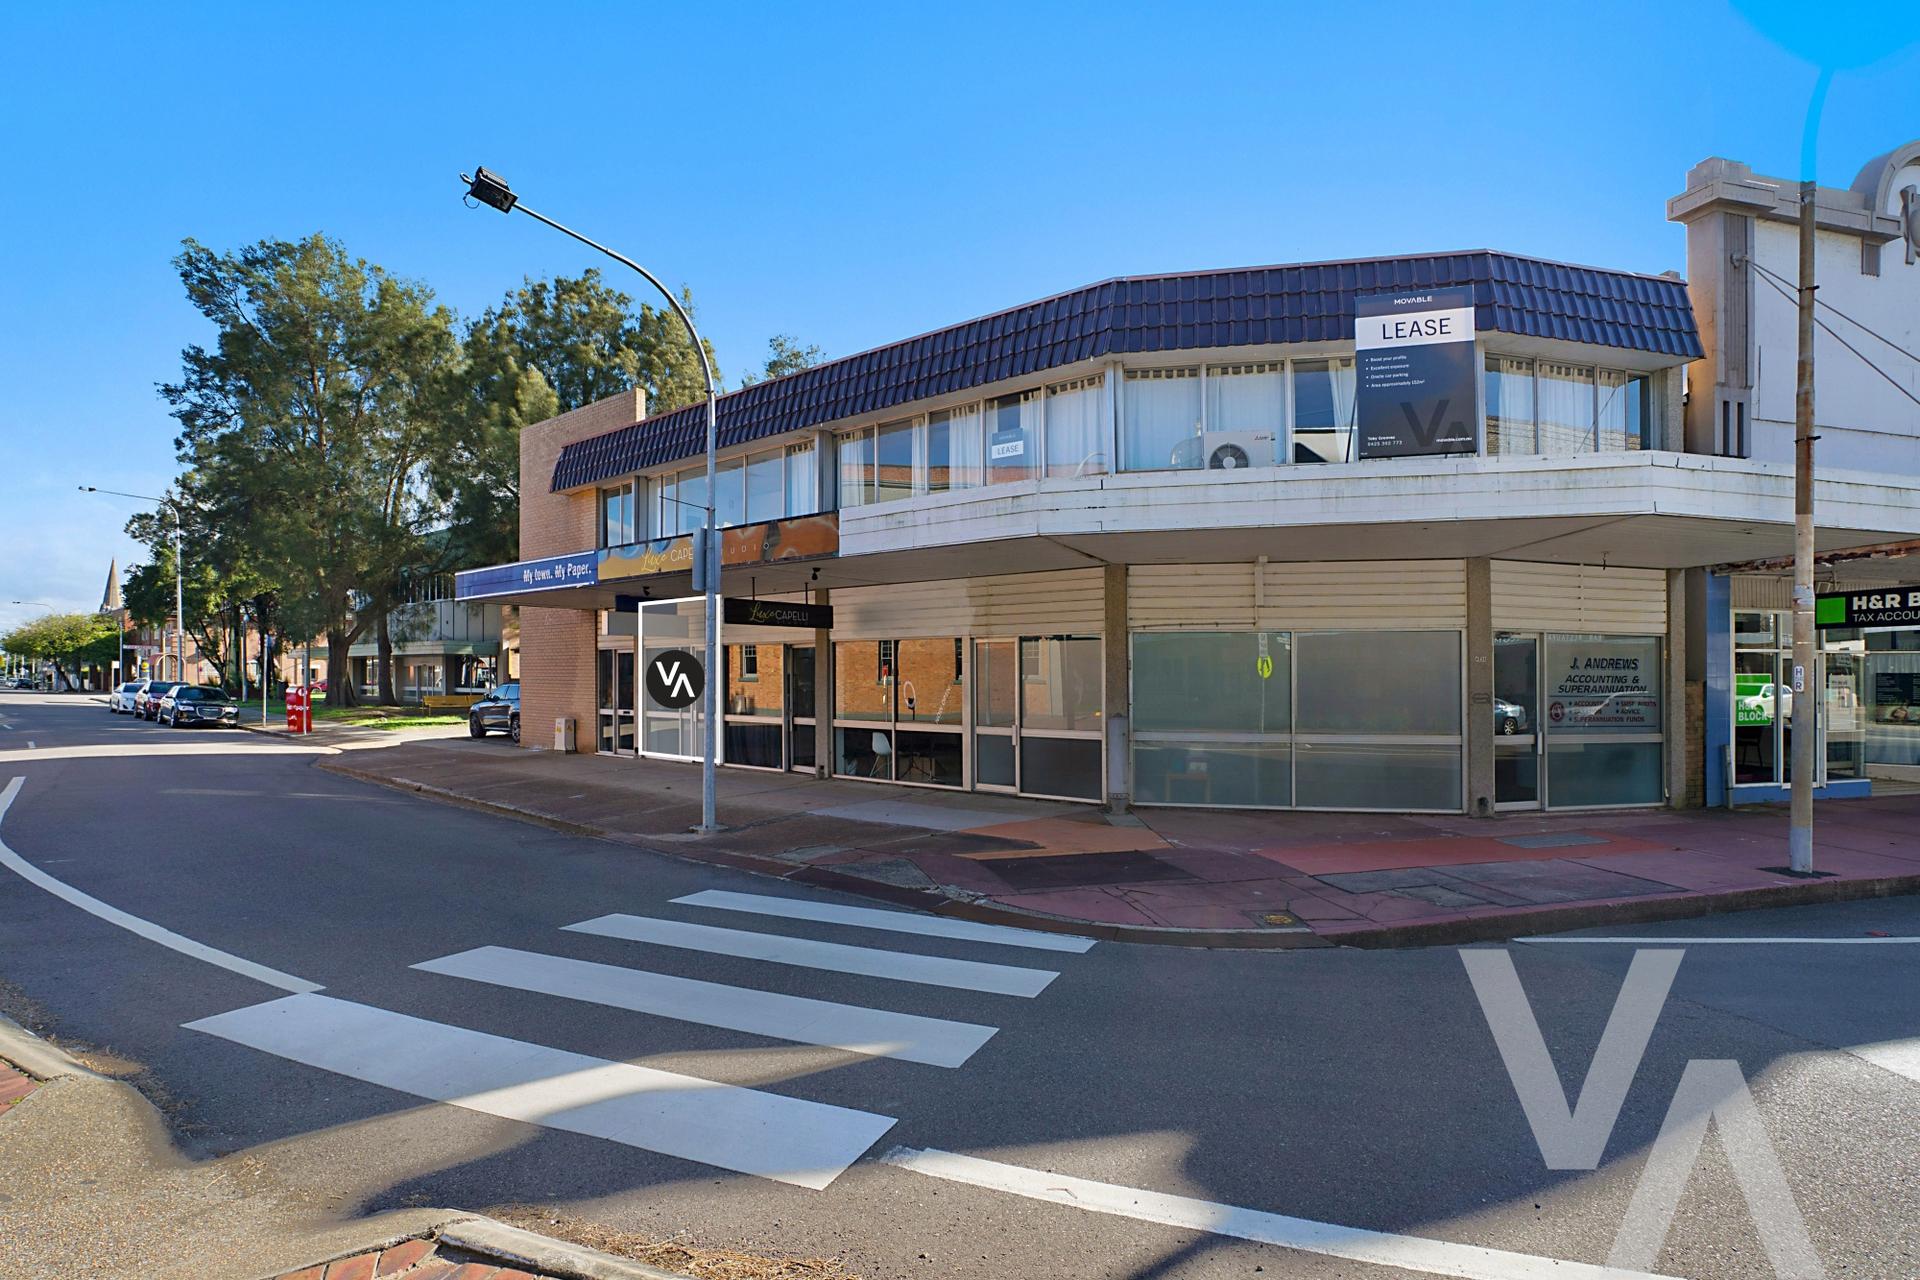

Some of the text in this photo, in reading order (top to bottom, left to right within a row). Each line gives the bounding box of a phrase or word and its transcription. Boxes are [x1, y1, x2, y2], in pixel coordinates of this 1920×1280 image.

[1394, 296, 1432, 304] MOVABLE
[1382, 318, 1451, 339] LEASE
[997, 444, 1019, 456] LEASE
[670, 547, 694, 562] CAPE
[523, 563, 592, 584] My town. My Paper.
[1852, 593, 1901, 611] H&R
[775, 609, 809, 622] CAPELLI
[1853, 613, 1875, 622] TAX
[1570, 658, 1639, 670] J. ANDREWS
[1795, 667, 1803, 676] H
[1564, 674, 1640, 684] ACCOUNTING &
[1557, 684, 1648, 694] SUPERANNUATION
[1795, 681, 1802, 690] R
[1738, 711, 1768, 721] BLOCK
